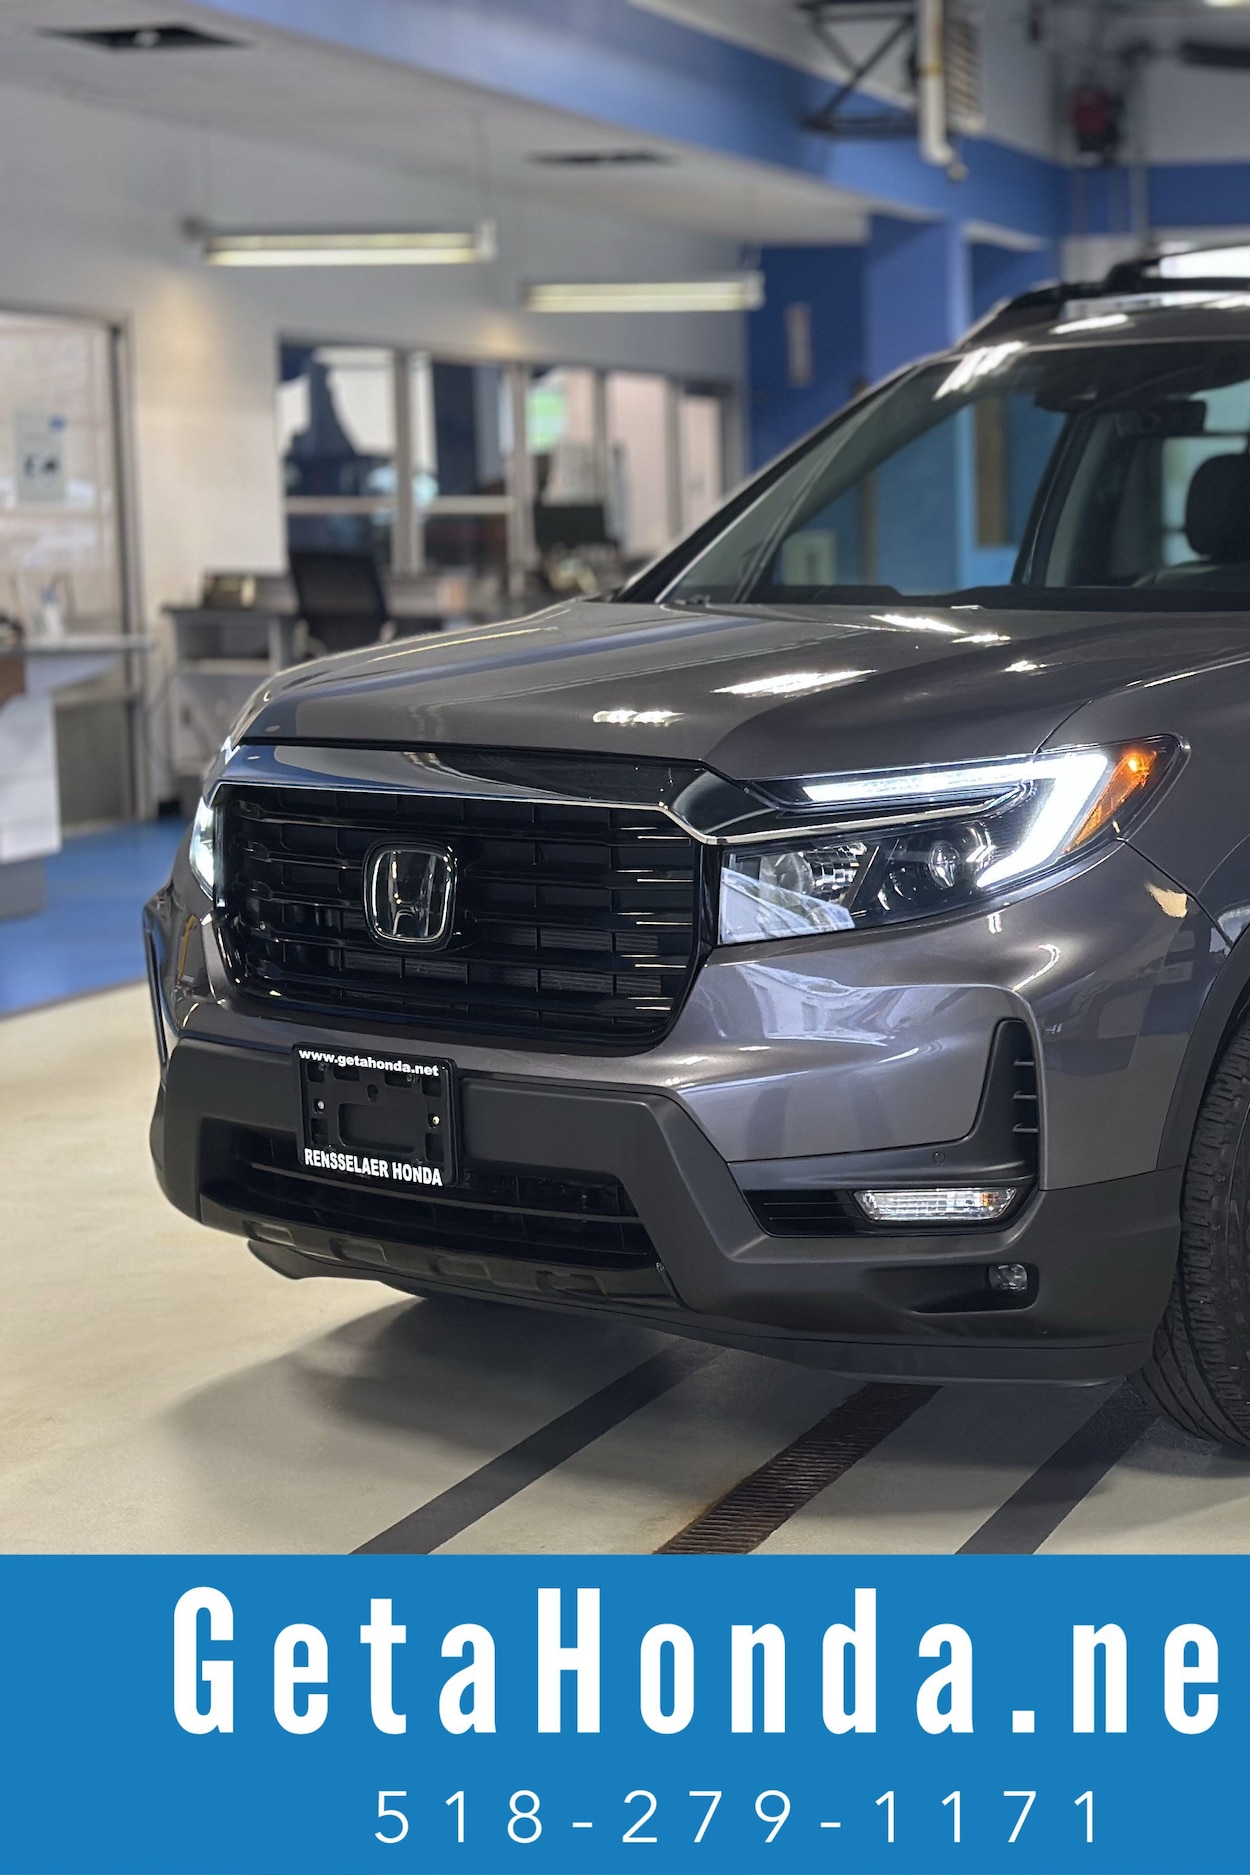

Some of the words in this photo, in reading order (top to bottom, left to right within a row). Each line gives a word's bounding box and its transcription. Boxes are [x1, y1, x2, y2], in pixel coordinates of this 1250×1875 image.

[299, 1050, 439, 1076] www.getahonda.net
[304, 1148, 389, 1178] RENSSELAER
[392, 1162, 443, 1186] HONDA
